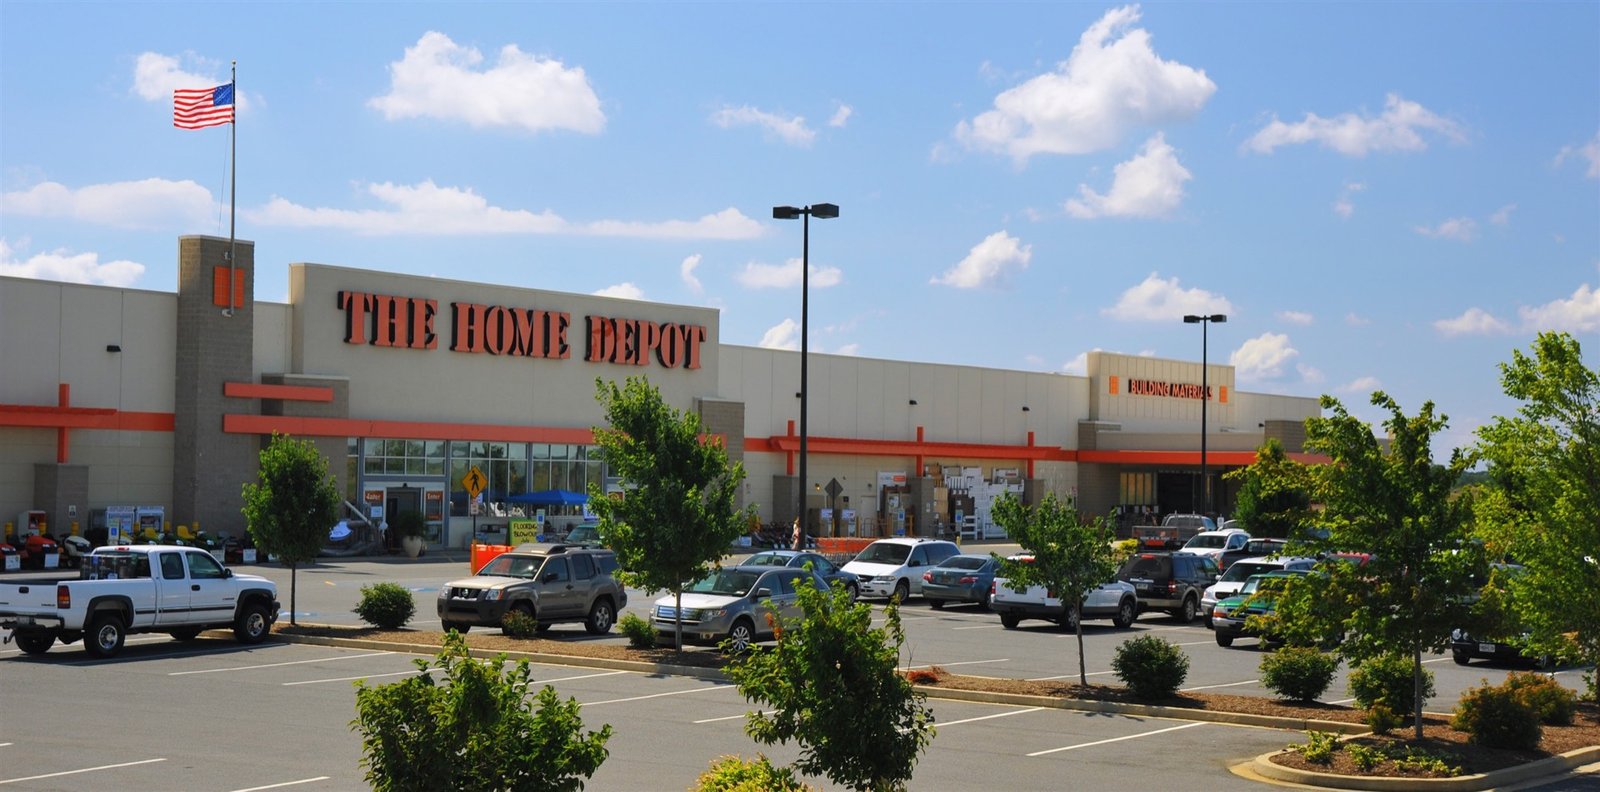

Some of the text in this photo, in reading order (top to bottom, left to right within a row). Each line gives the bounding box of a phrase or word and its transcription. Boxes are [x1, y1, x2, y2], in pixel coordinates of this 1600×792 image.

[338, 291, 706, 370] THE HOME DEPOT
[1129, 379, 1213, 400] BUILDING MATERIAS
